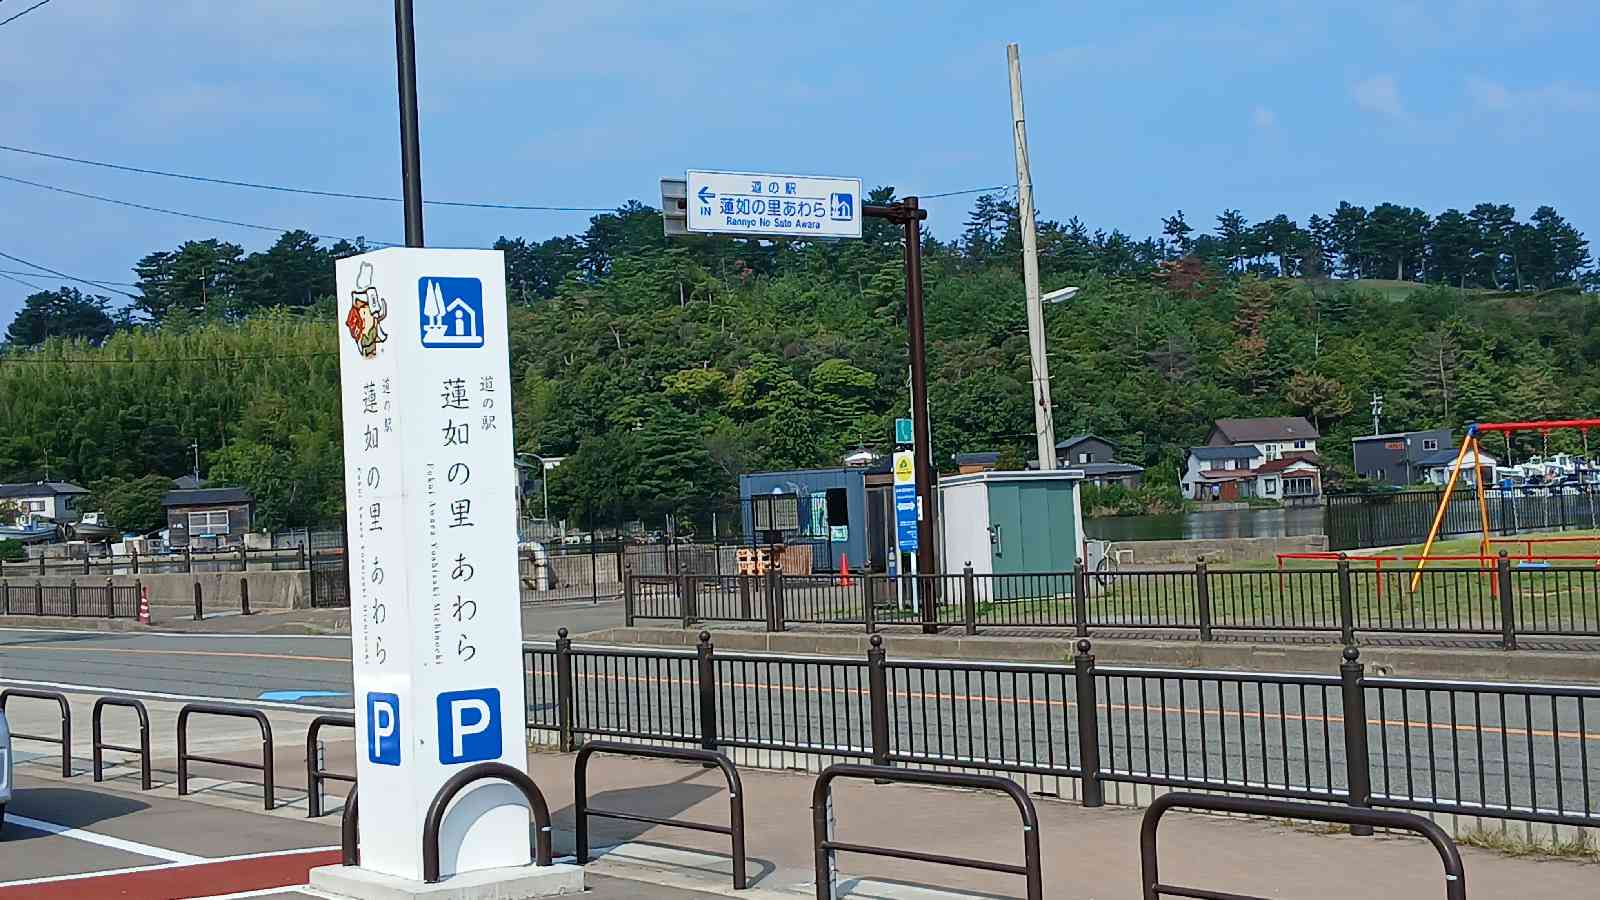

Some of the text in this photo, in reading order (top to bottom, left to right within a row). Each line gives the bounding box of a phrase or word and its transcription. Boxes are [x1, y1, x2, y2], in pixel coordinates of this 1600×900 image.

[751, 181, 796, 195] 道の駅
[700, 206, 711, 216] IN
[719, 197, 826, 217] 蓮如の里あわら
[759, 218, 770, 227] No
[795, 219, 820, 230] Awara
[480, 376, 497, 431] 道の駅
[373, 701, 395, 758] P
[451, 699, 491, 758] P
